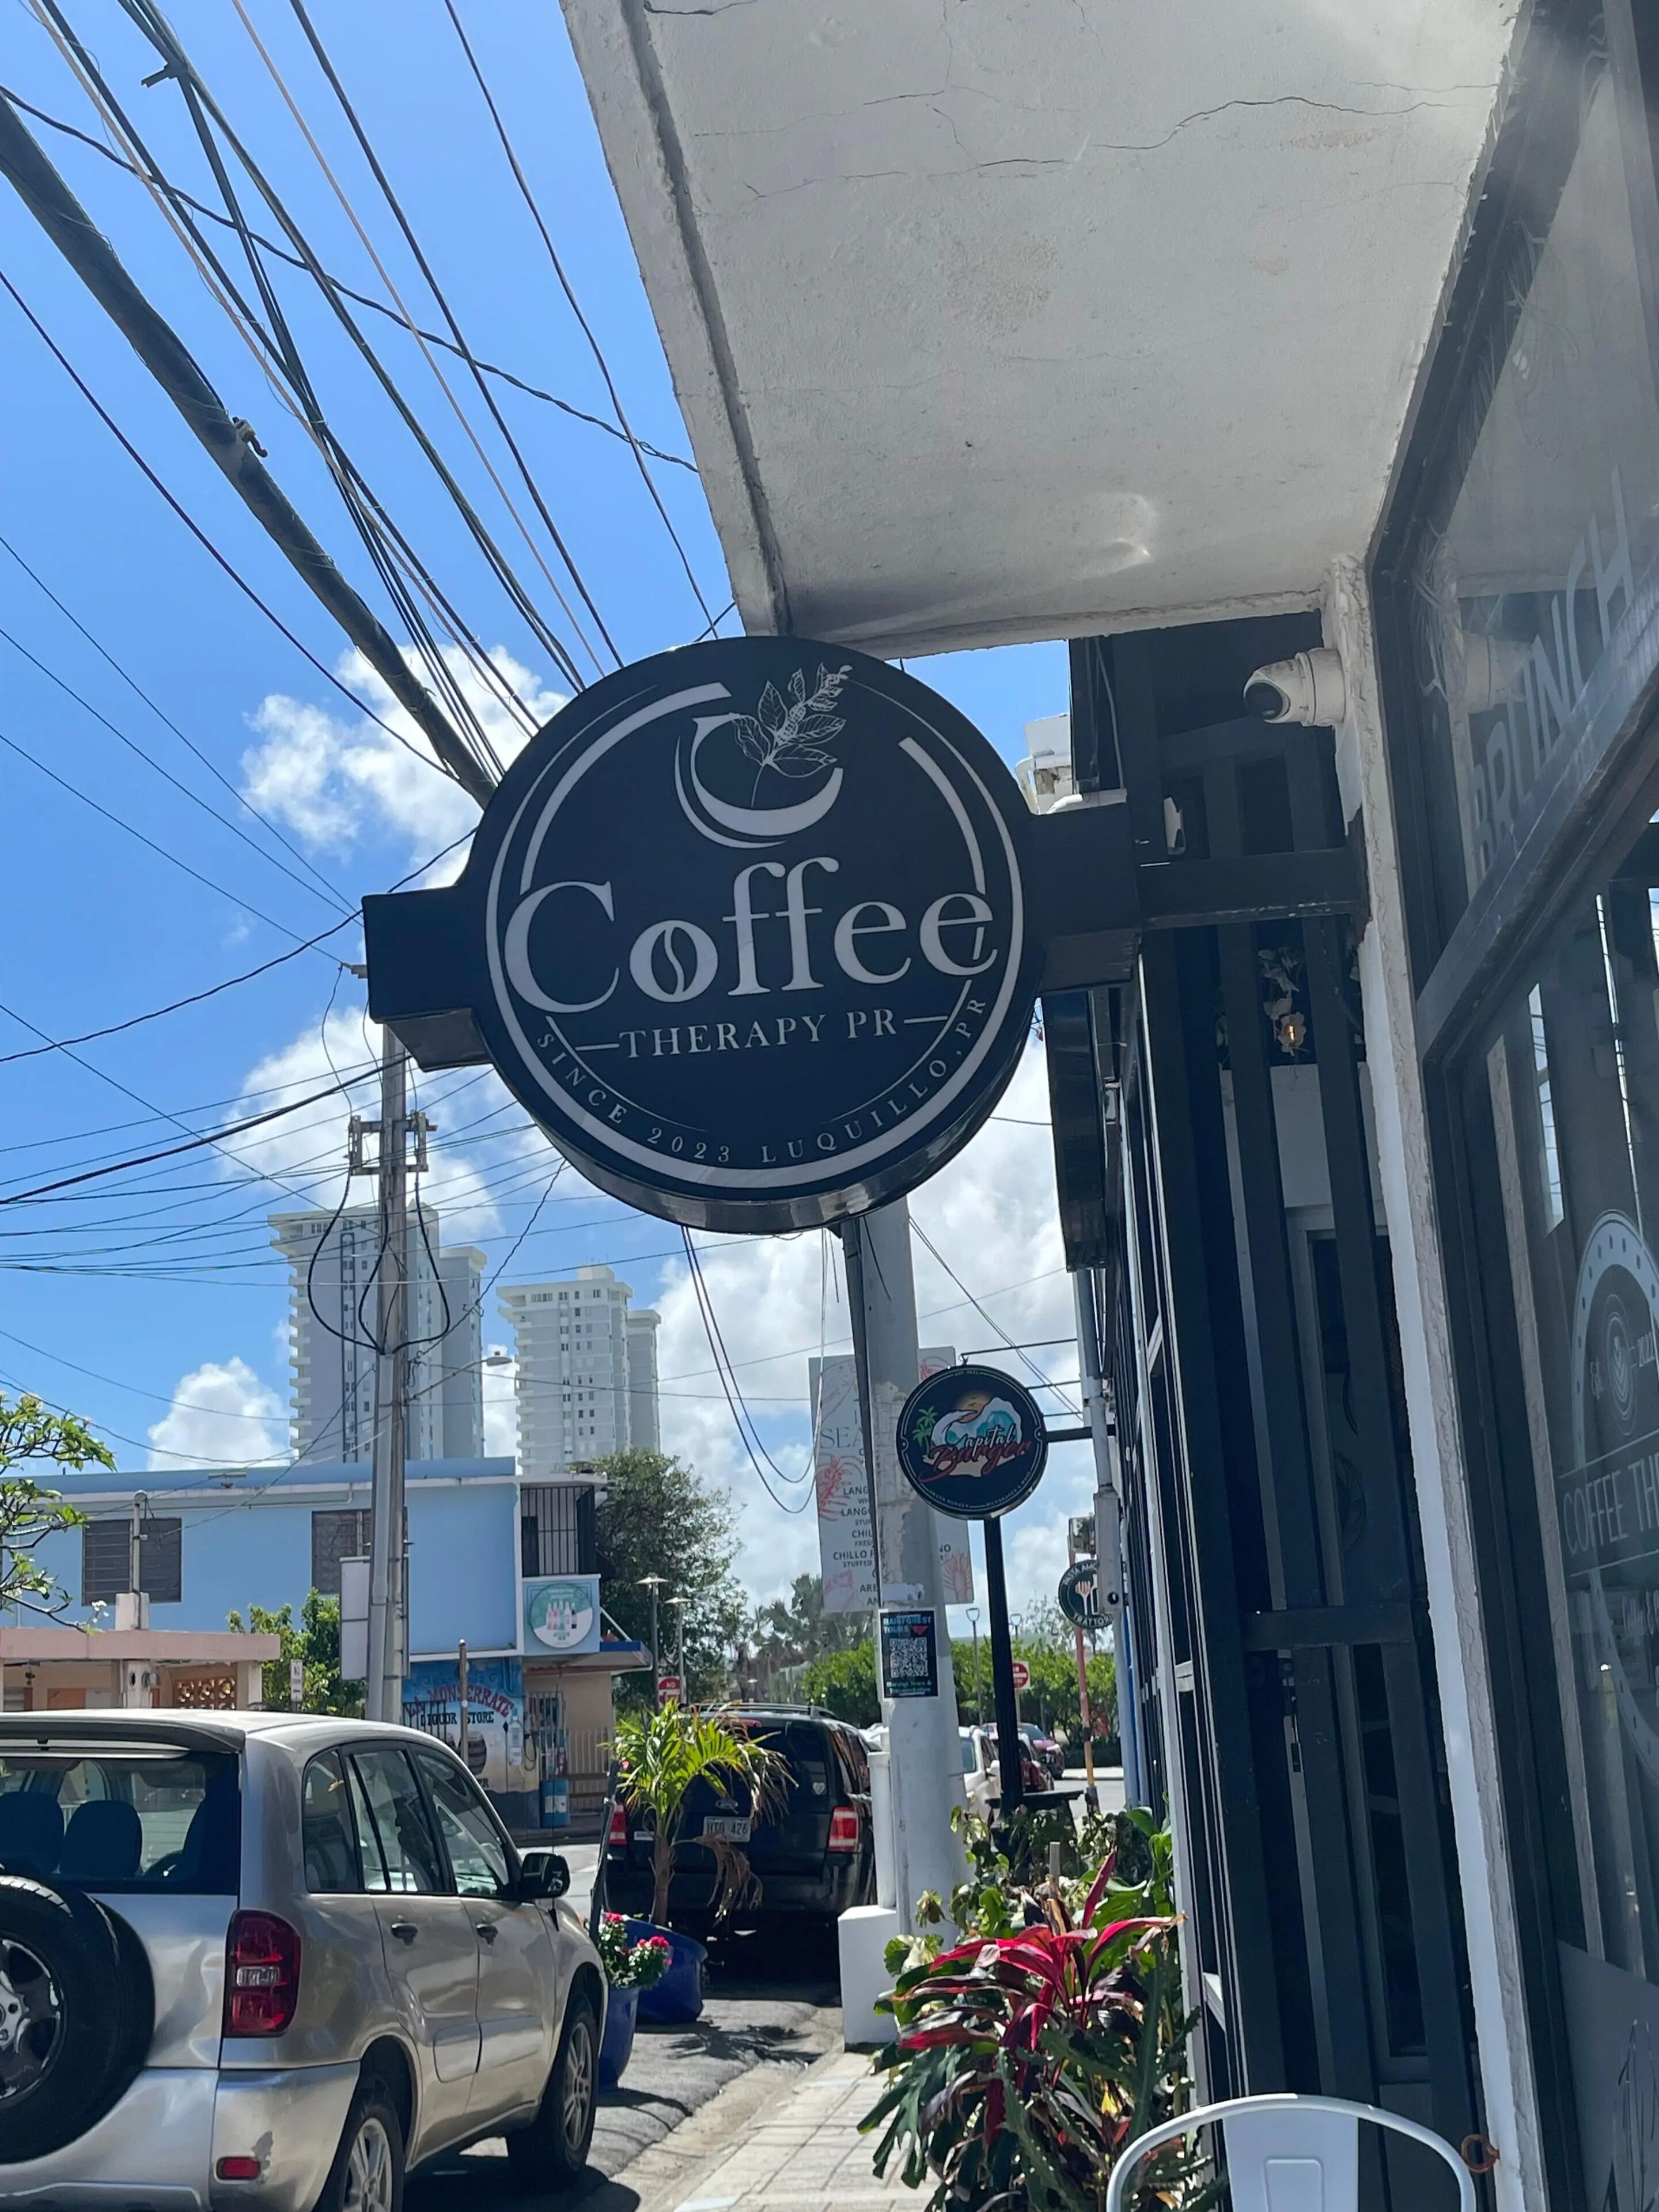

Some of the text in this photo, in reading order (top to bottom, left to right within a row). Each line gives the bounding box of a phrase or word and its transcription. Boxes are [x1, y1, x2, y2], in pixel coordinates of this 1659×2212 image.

[504, 857, 998, 1014] Coffee
[619, 1008, 897, 1059] THERAPY PR
[537, 1033, 628, 1124] SINCE
[647, 1127, 730, 1162] 2023
[918, 1440, 1031, 1483] Burger
[1563, 1469, 1628, 1556] COFFEE
[833, 1550, 868, 1560] CHILLO
[843, 1560, 872, 1569] STUFFED
[883, 1616, 931, 1626] RAINFOREST
[883, 1625, 909, 1634] TOURS
[730, 1821, 748, 1835] 426
